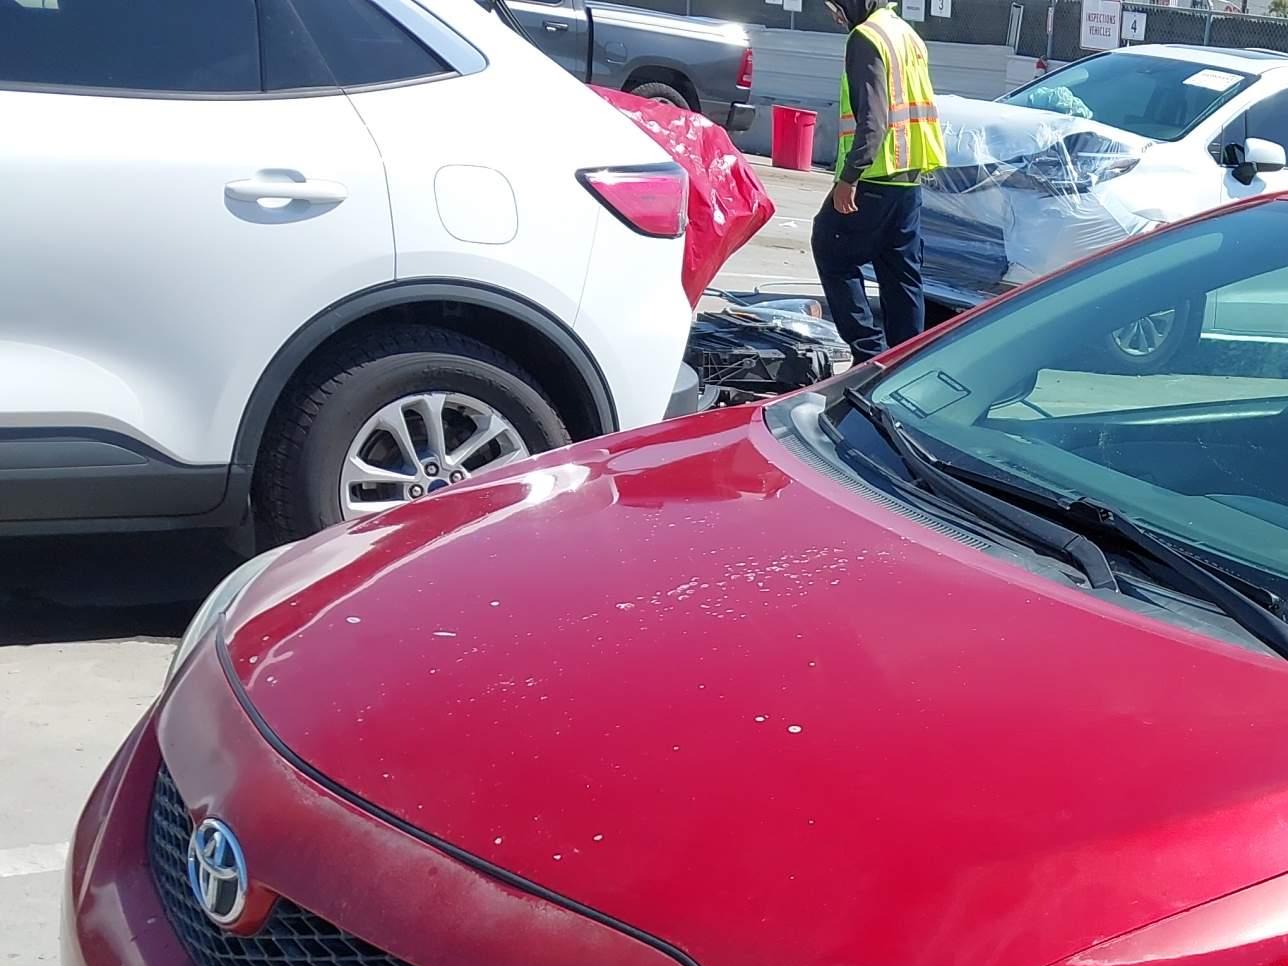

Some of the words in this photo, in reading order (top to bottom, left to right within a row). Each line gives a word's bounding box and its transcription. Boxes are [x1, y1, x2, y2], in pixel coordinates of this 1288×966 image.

[1087, 12, 1116, 25] INSPECTIONS
[1089, 25, 1111, 37] VEHICLES
[1130, 19, 1137, 33] 4
